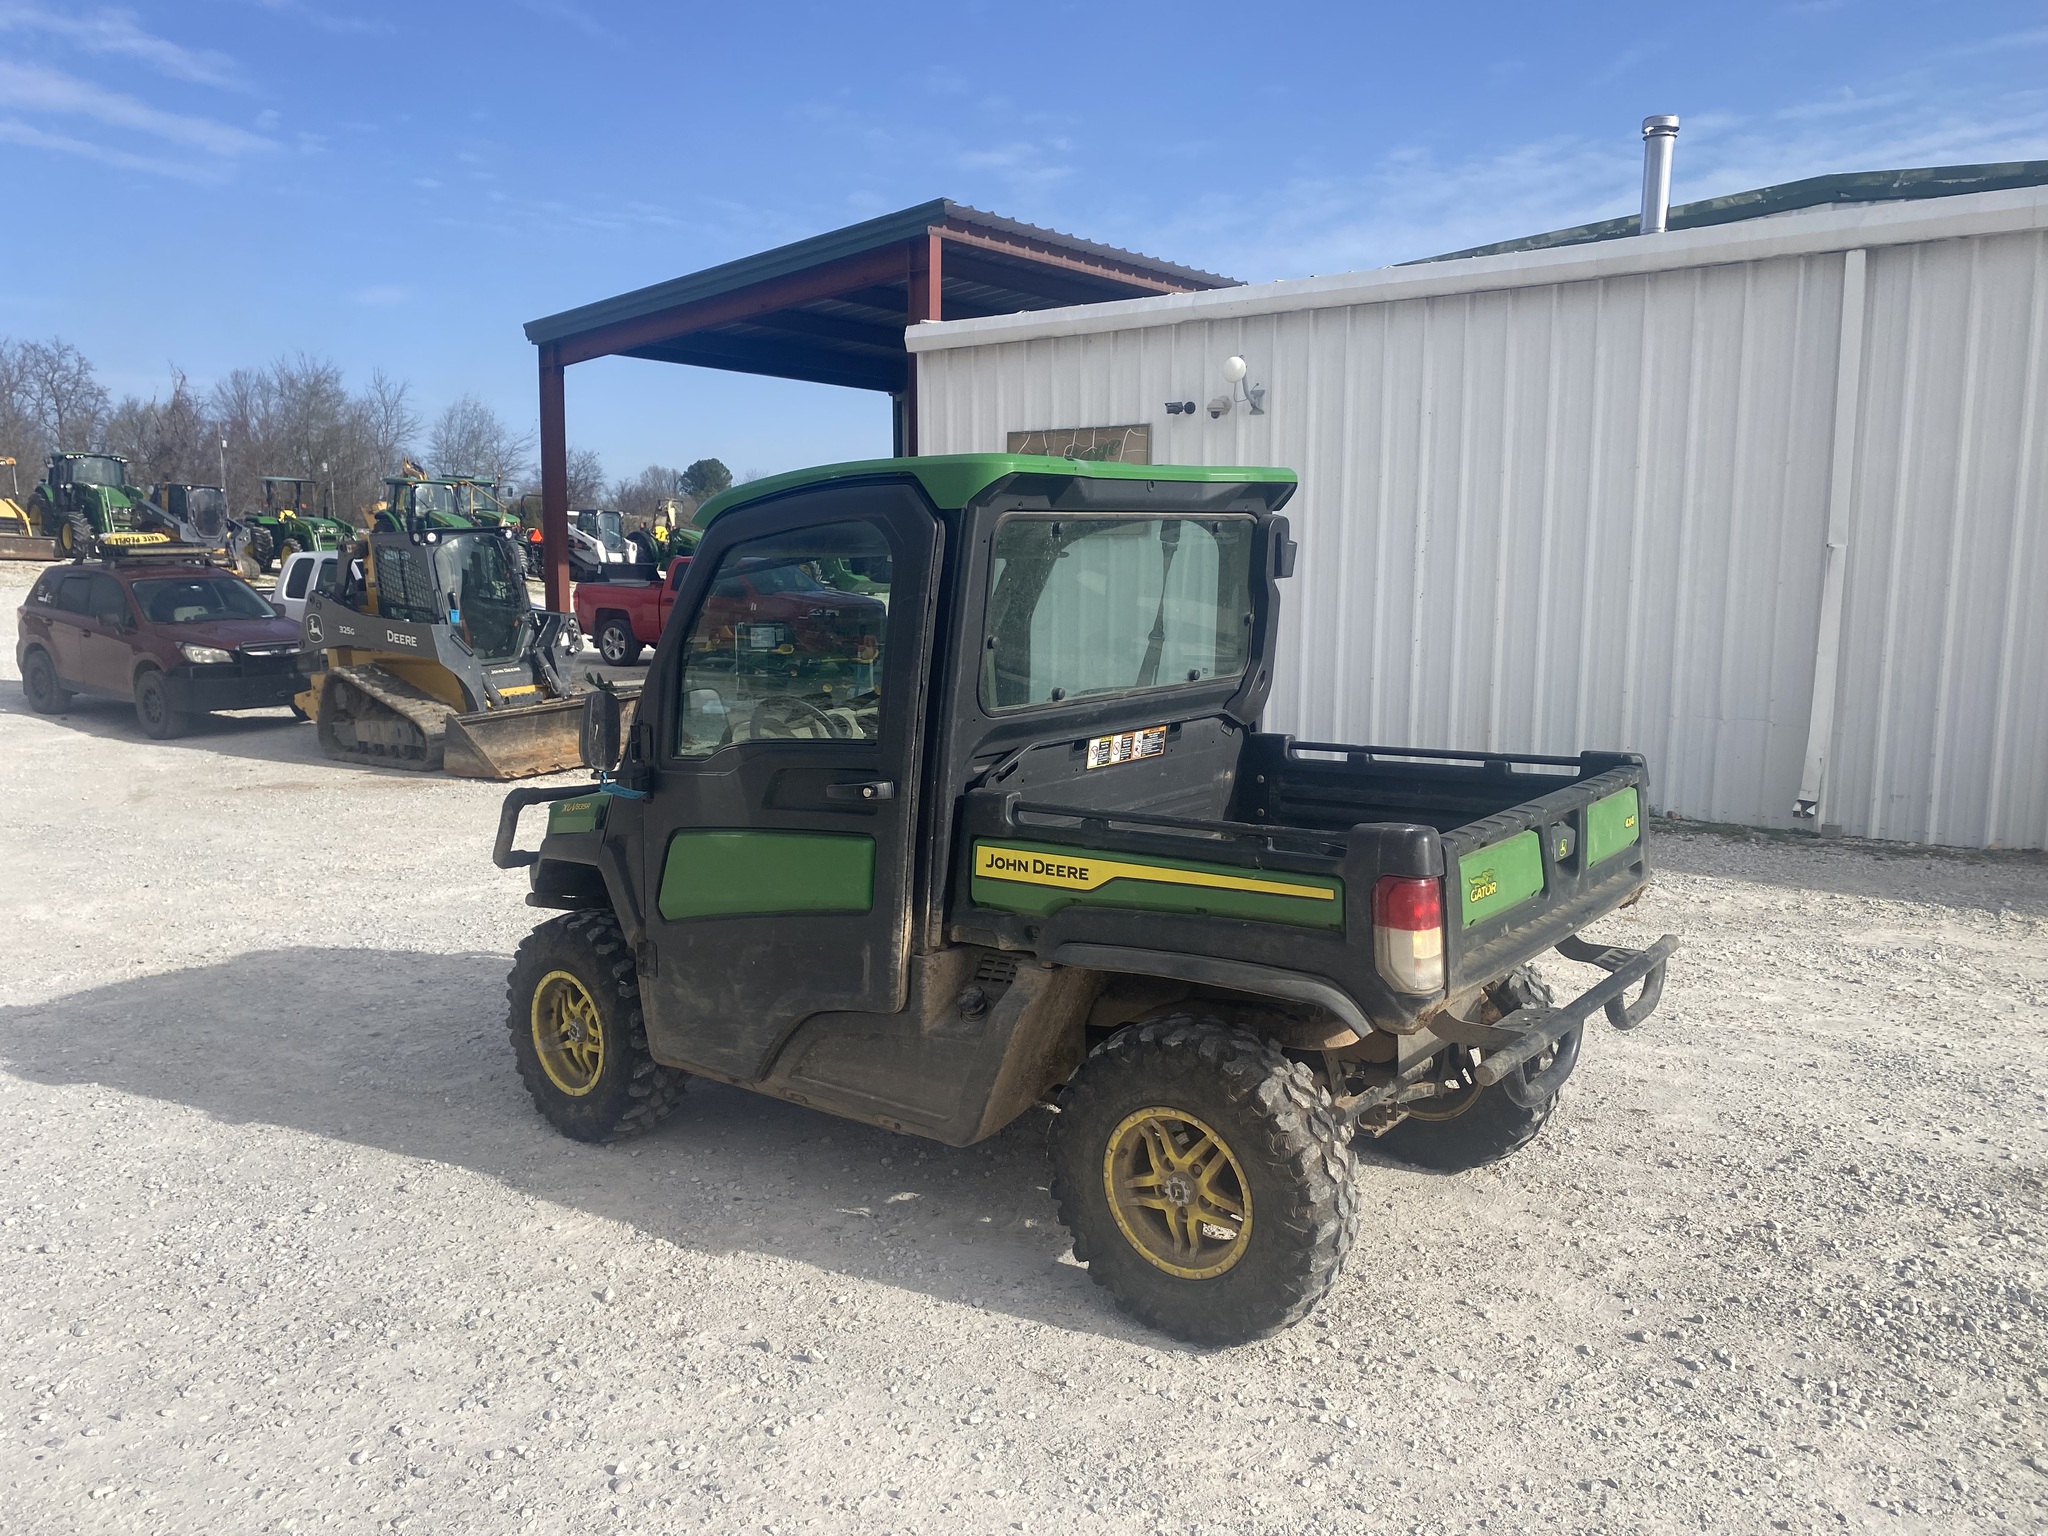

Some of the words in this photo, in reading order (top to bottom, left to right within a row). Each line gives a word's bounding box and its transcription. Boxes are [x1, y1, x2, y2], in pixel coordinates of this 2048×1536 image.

[339, 625, 355, 635] 325G
[386, 629, 418, 647] DEERE
[985, 853, 1029, 873] JOHN
[1032, 859, 1089, 881] DEERE
[1470, 882, 1497, 902] GATOR
